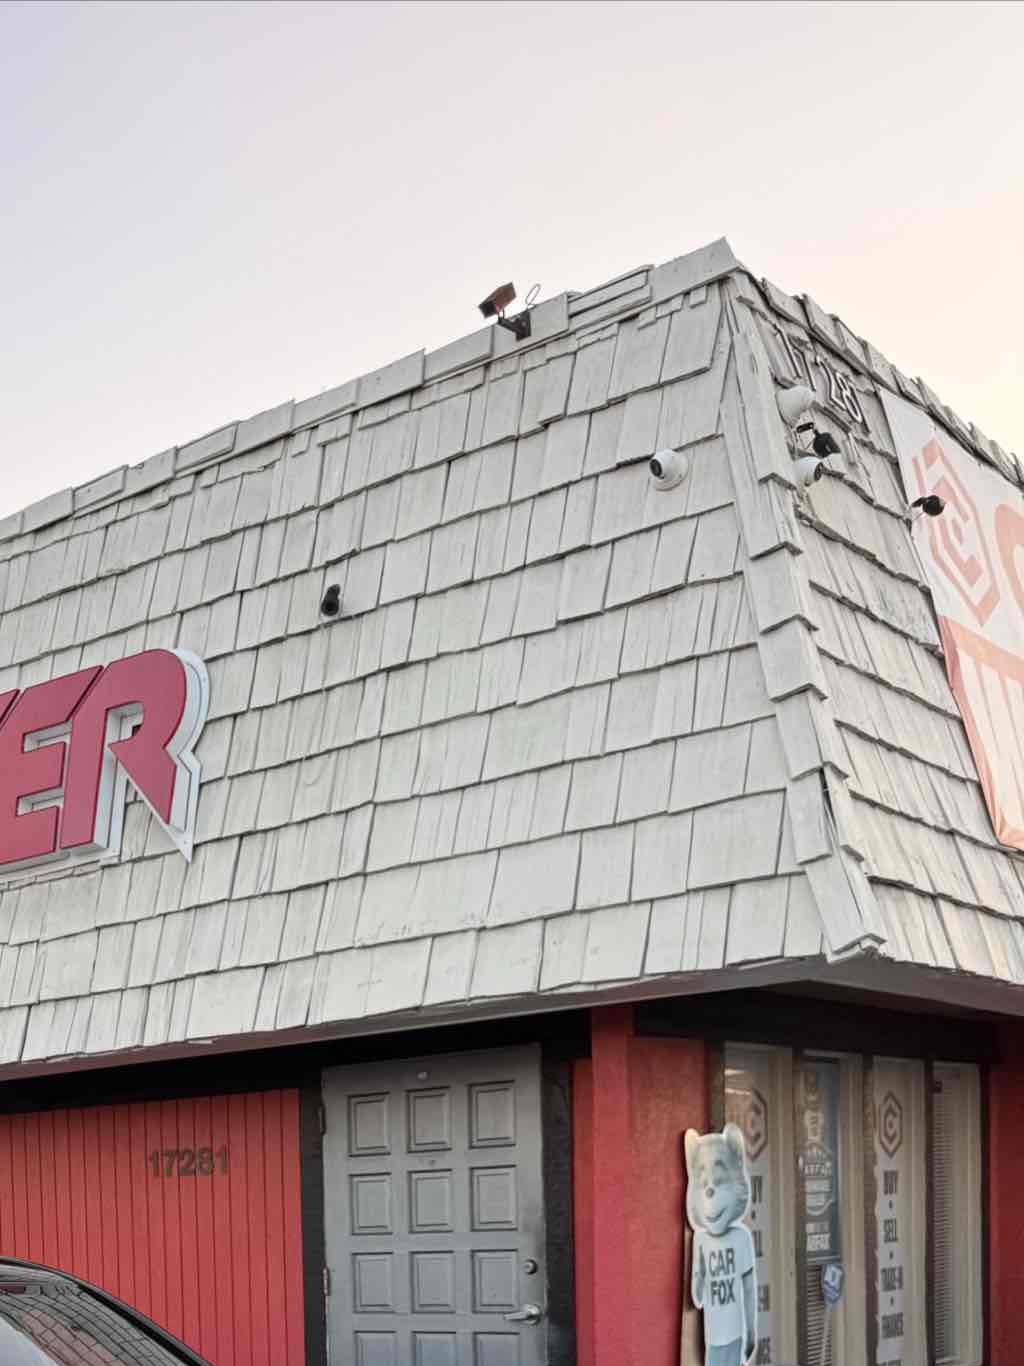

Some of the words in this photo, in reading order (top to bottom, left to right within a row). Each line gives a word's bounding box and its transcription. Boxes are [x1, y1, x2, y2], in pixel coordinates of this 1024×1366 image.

[148, 1146, 228, 1178] 17281
[708, 1248, 736, 1277] CAR
[711, 1278, 736, 1307] FOX
